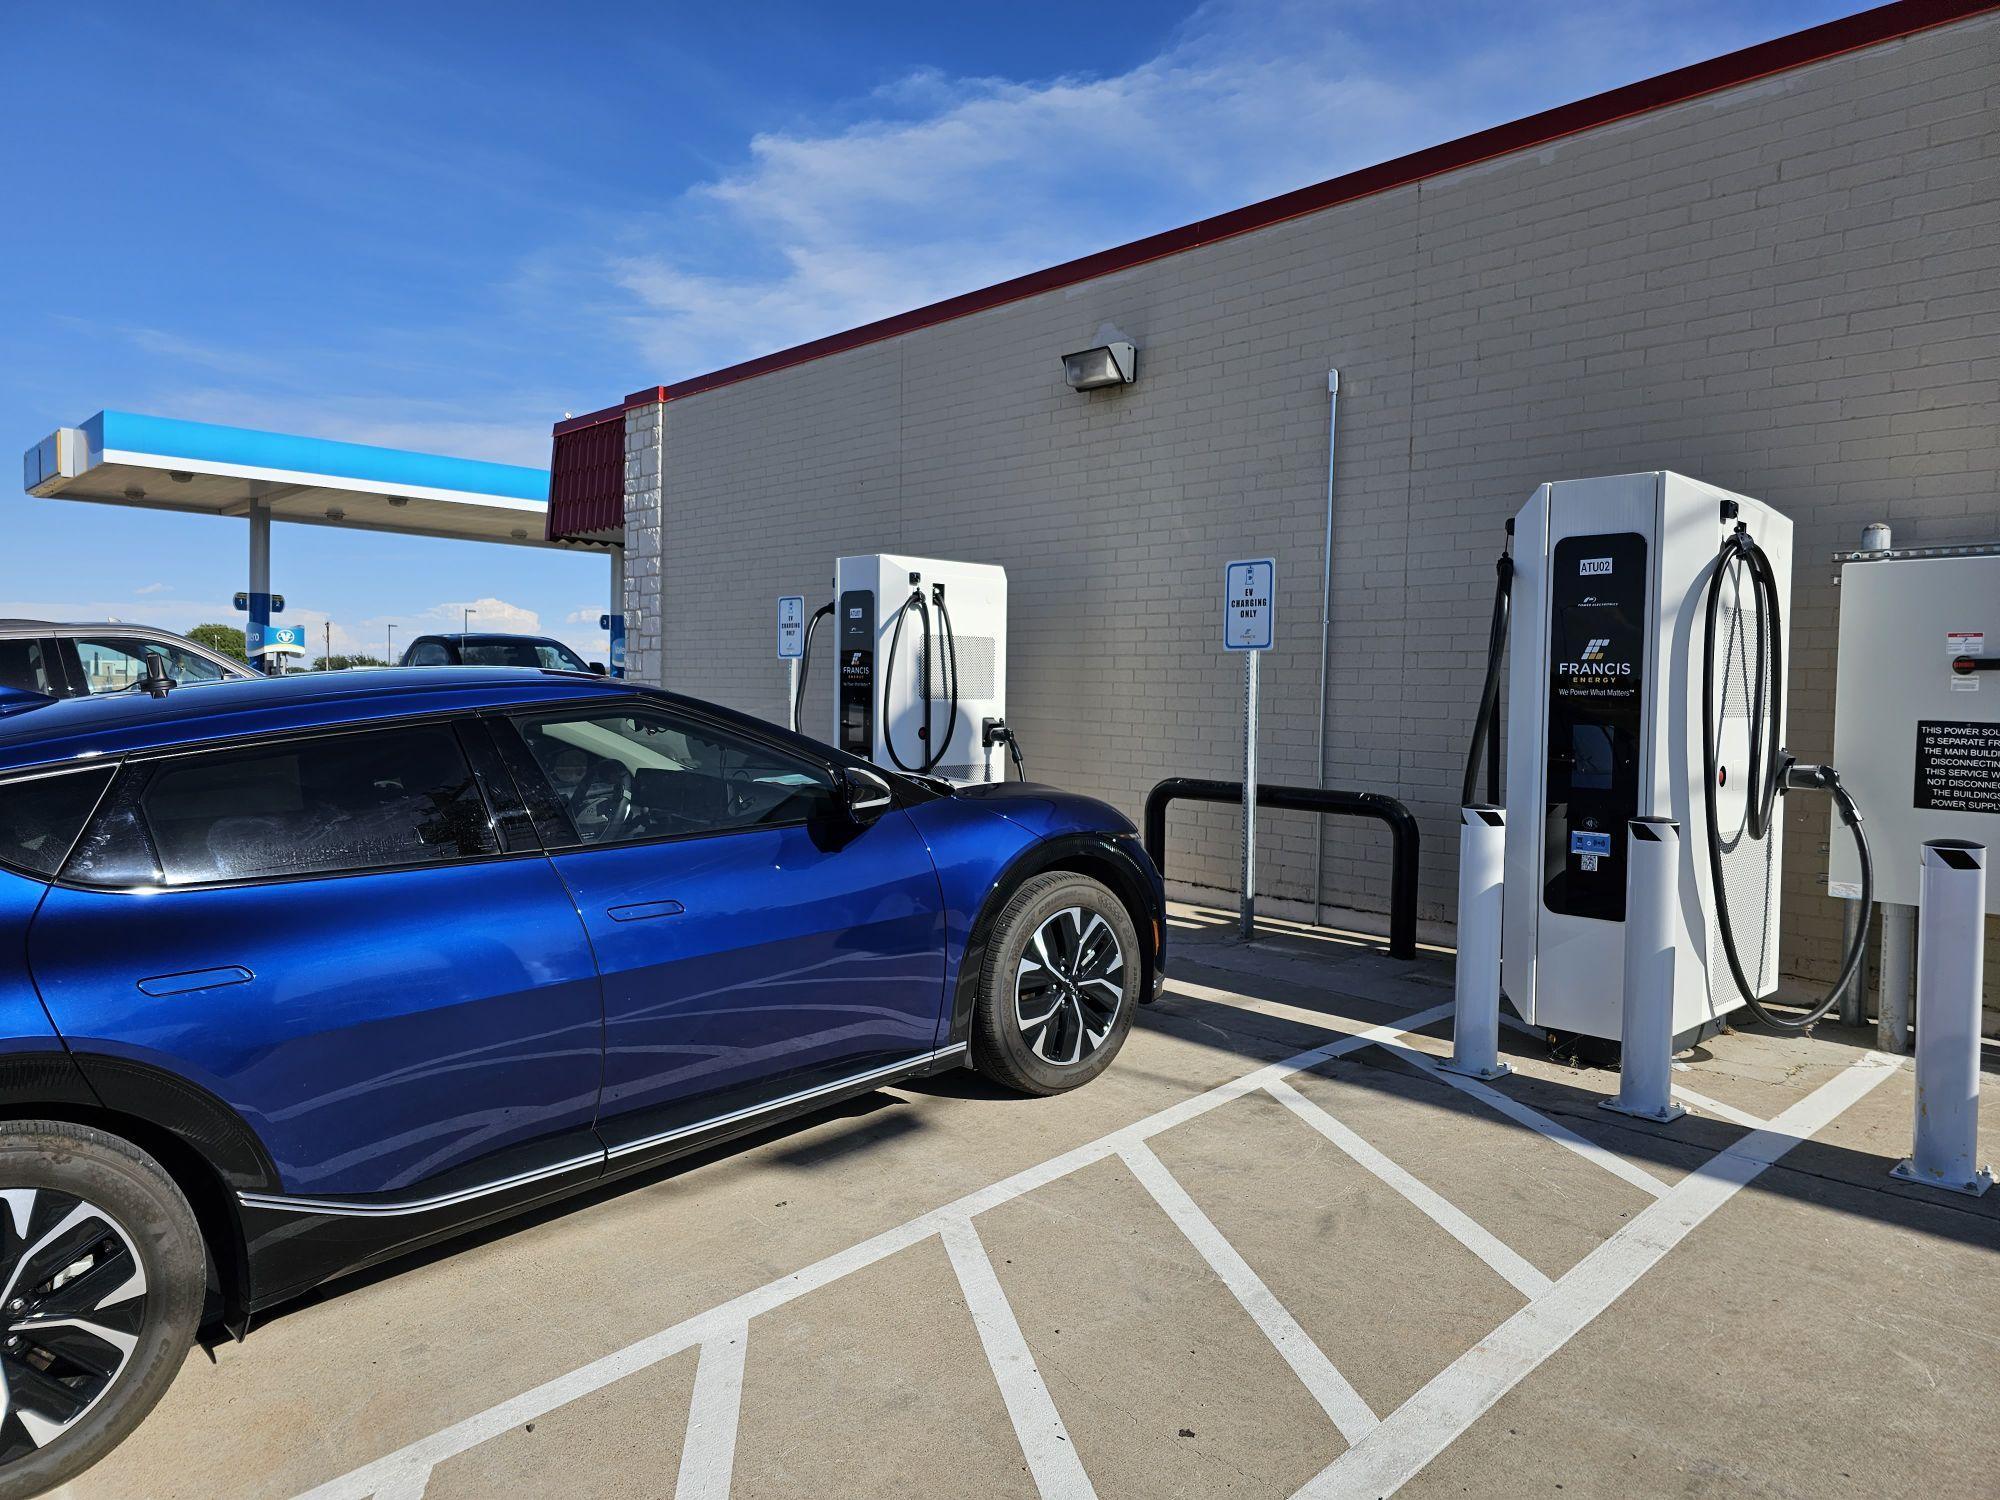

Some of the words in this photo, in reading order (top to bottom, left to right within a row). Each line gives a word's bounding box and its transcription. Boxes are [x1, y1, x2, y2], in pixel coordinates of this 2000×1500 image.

[1581, 561, 1610, 572] ATU02
[1244, 588, 1254, 596] EV
[1231, 598, 1267, 608] CHARGING
[1240, 610, 1257, 618] ONLY
[843, 666, 870, 674] FRANCIS
[1559, 662, 1631, 675] FRANCIS
[1921, 726, 1942, 734] THIS
[1944, 727, 1979, 736] POWER
[1926, 736, 1934, 744] IS
[1936, 737, 1986, 746] SEPARATE
[1924, 746, 1942, 754] THE
[1944, 748, 1968, 756] MAIN
[1930, 758, 2000, 768] DISCONNECTIN
[1924, 768, 1946, 776] THIS
[1948, 768, 1988, 778] SERVICE
[1926, 778, 1946, 786] NOT
[1932, 788, 1950, 796] THE
[1930, 799, 1966, 808] POWER
